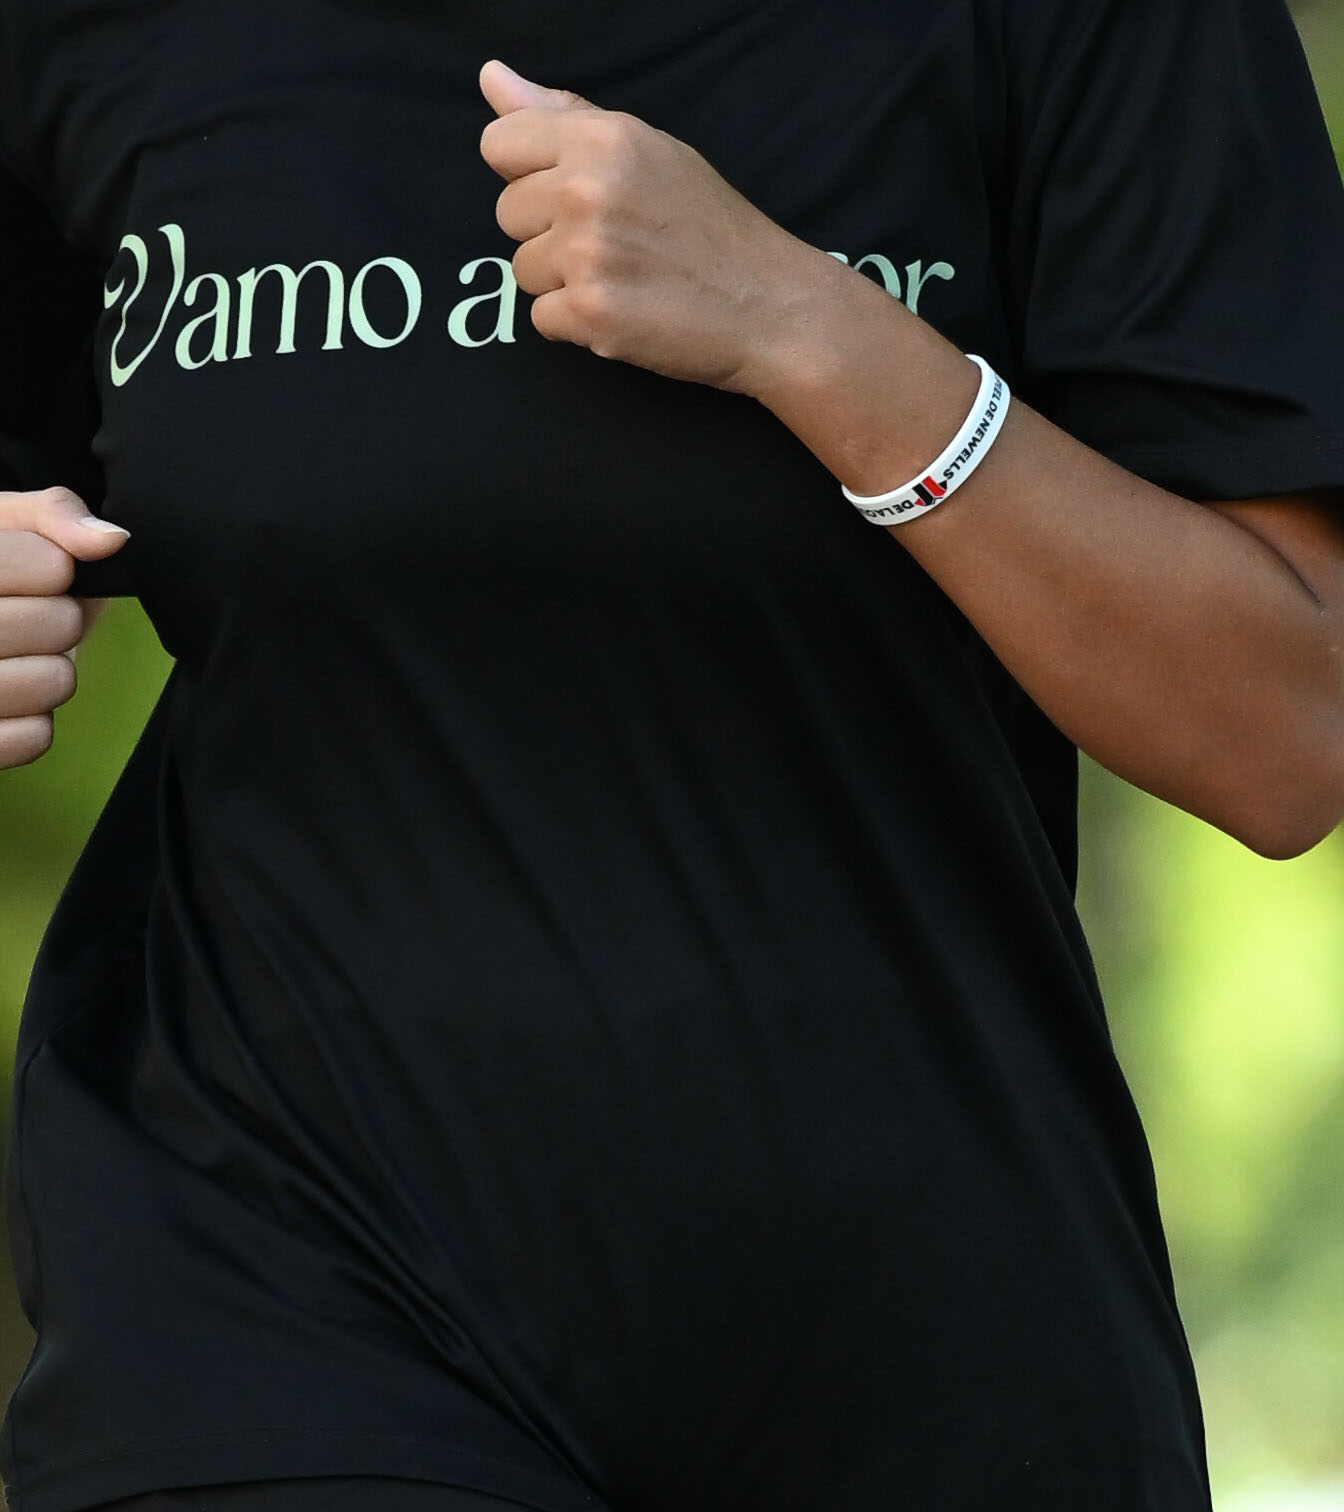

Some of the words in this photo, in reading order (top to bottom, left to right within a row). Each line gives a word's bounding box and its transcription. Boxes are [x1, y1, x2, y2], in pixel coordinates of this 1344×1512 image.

[103, 222, 422, 388] Vamo
[985, 400, 998, 421] DE
[943, 417, 991, 480] NEWELLS
